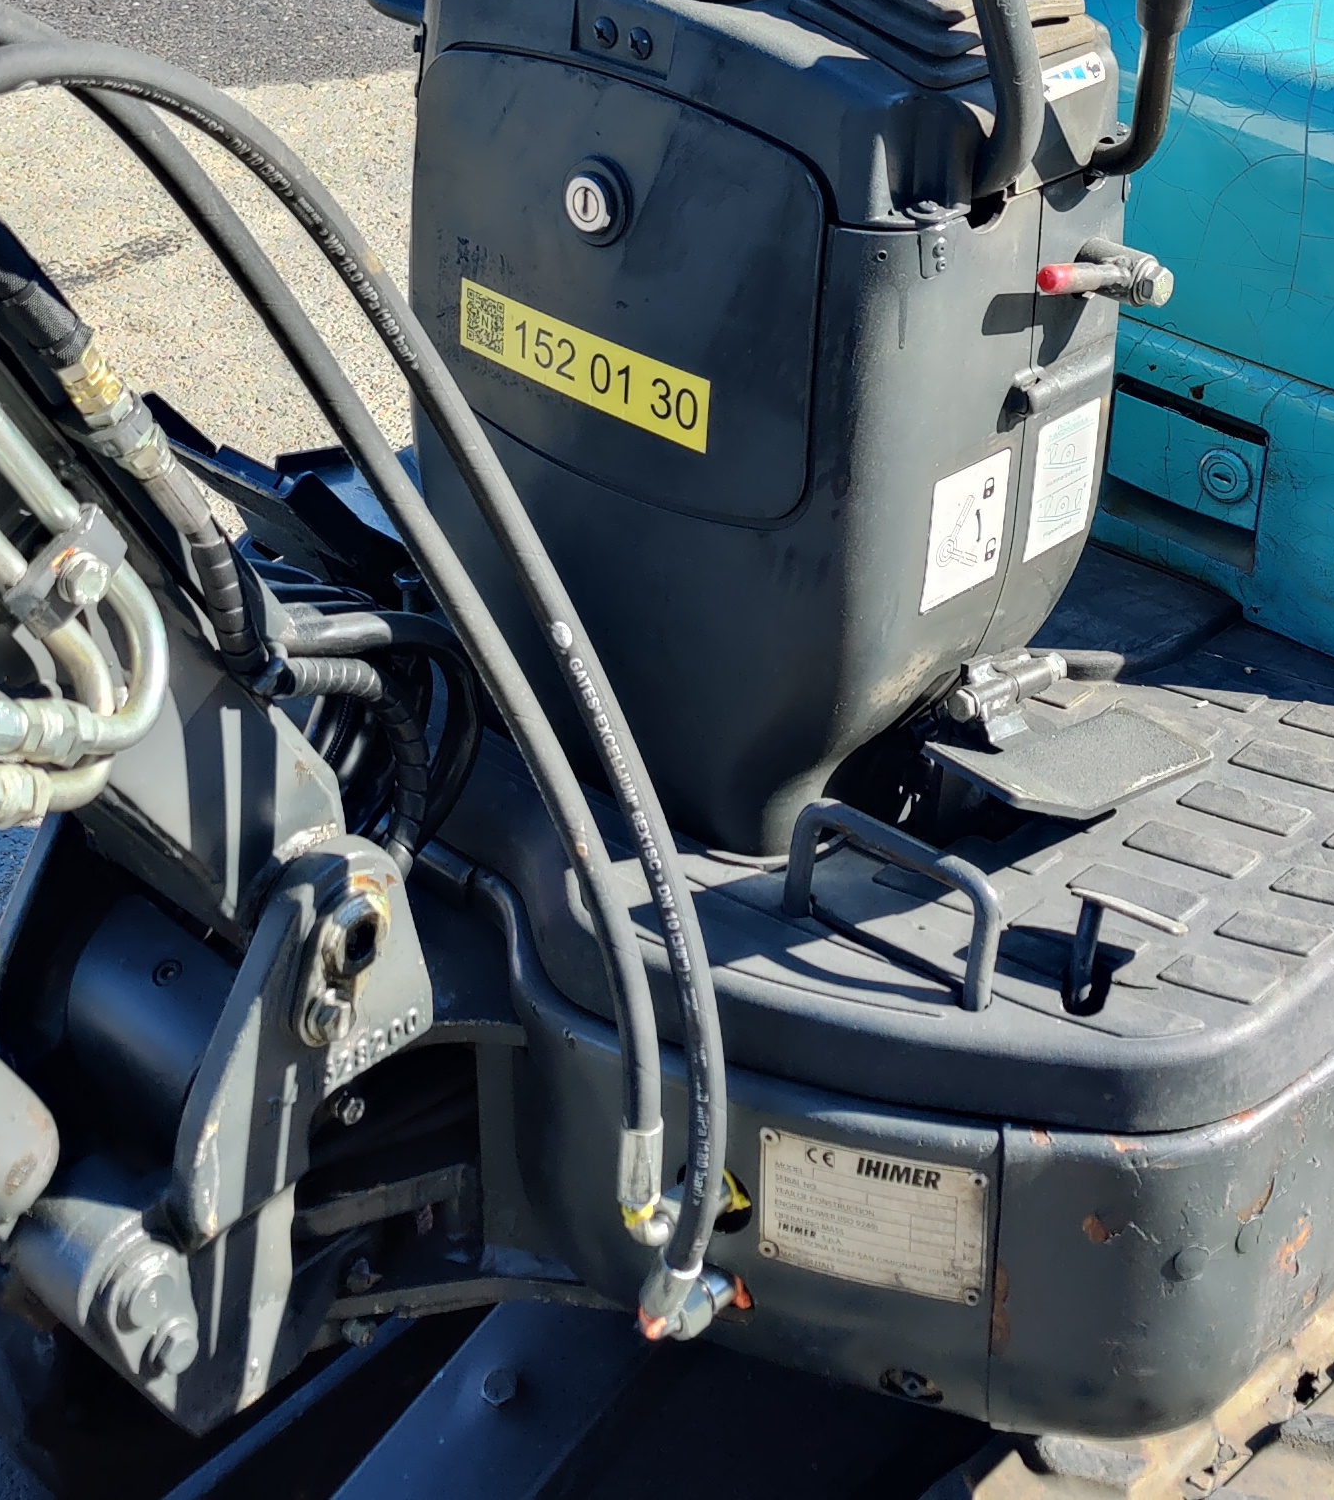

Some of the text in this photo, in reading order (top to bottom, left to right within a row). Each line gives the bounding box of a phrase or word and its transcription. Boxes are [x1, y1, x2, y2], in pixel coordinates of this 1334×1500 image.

[515, 320, 698, 430] 152 01 30
[569, 657, 601, 711] GATES
[656, 884, 675, 909] DN
[856, 1156, 942, 1191] IHIMER
[778, 1221, 817, 1239] IHIMER
